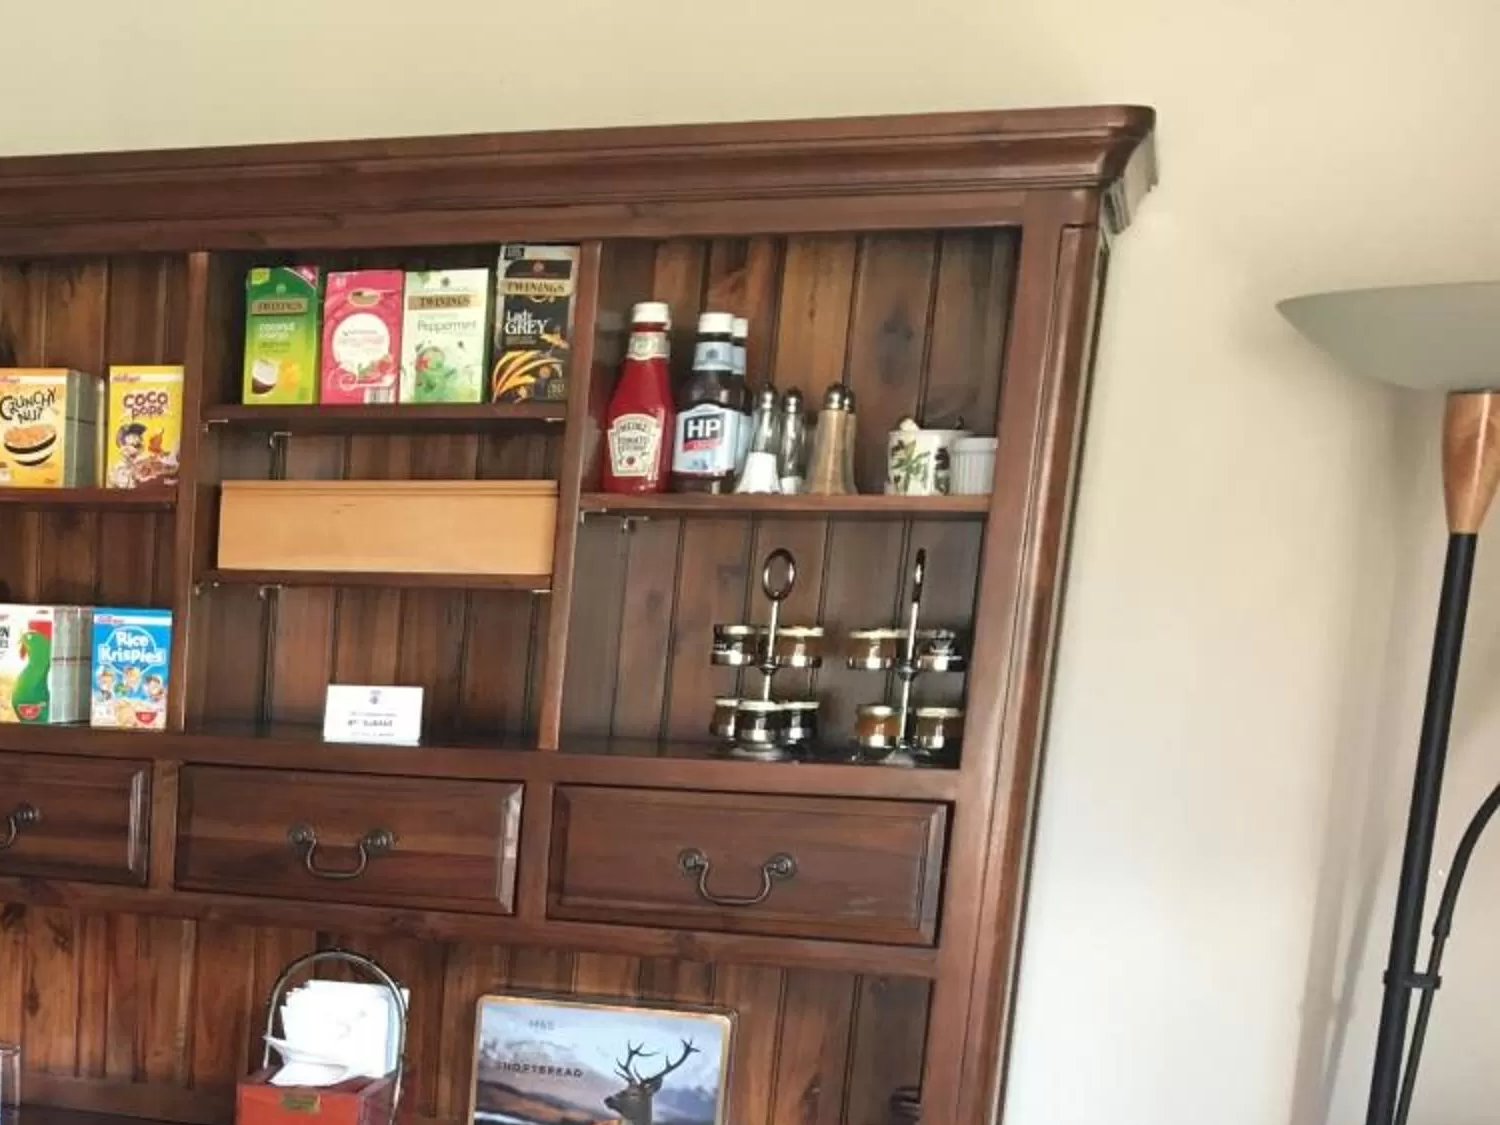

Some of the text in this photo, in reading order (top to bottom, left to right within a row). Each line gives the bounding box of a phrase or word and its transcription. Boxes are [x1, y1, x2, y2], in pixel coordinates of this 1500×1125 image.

[507, 281, 566, 293] TWININGS
[505, 318, 552, 335] GREY
[123, 391, 168, 409] COCO
[17, 406, 43, 424] NUT
[687, 418, 721, 439] HP
[115, 630, 150, 648] Rice
[97, 643, 167, 665] Krispies
